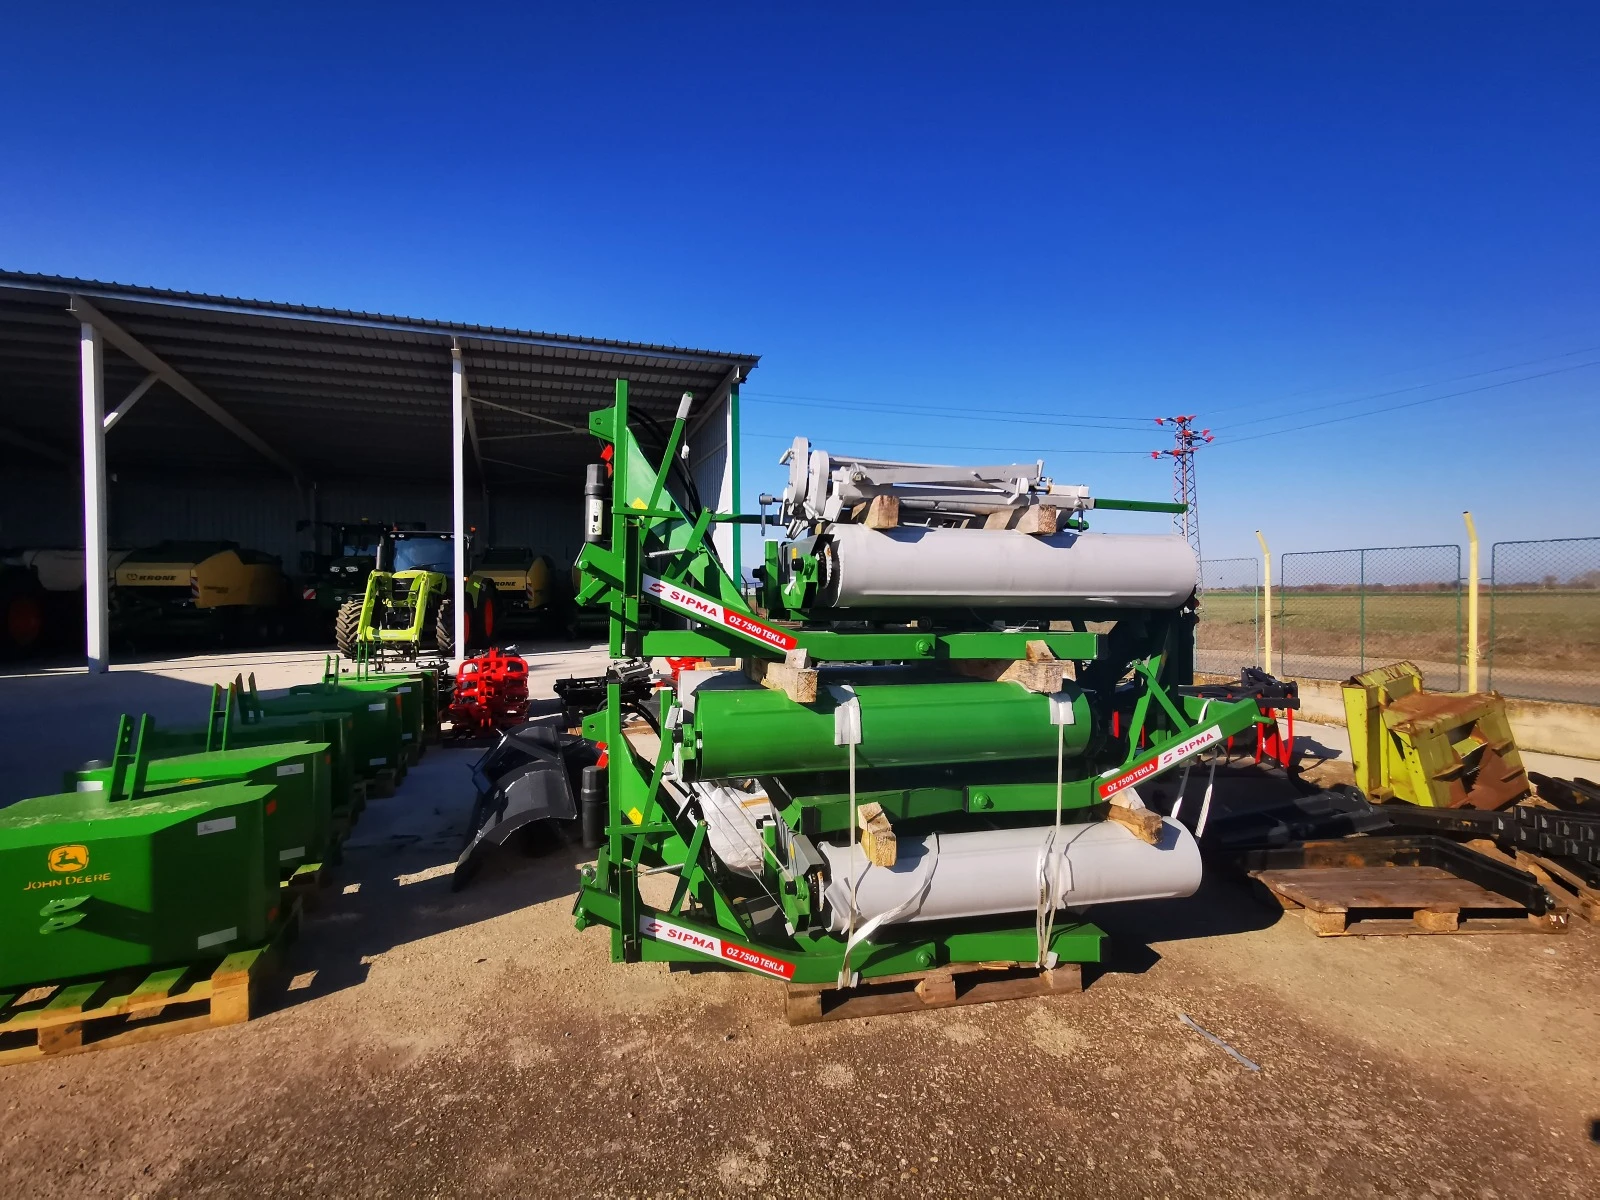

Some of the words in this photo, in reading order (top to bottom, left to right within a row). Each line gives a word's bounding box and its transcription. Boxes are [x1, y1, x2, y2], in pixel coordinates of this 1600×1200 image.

[670, 591, 717, 617] SIPMA
[729, 615, 741, 626] OZ
[742, 621, 761, 635] 7500
[762, 630, 787, 646] TEKLA
[1107, 781, 1118, 792] OZ
[1118, 774, 1134, 786] 7500
[1134, 764, 1155, 778] TEKLA
[1177, 733, 1214, 755] SIPMA
[23, 880, 62, 891] JOHN
[65, 872, 111, 885] DEERE
[667, 928, 715, 951] SIPMA
[726, 947, 738, 957] OZ
[740, 951, 759, 964] 7500
[760, 958, 784, 973] TEKLA
